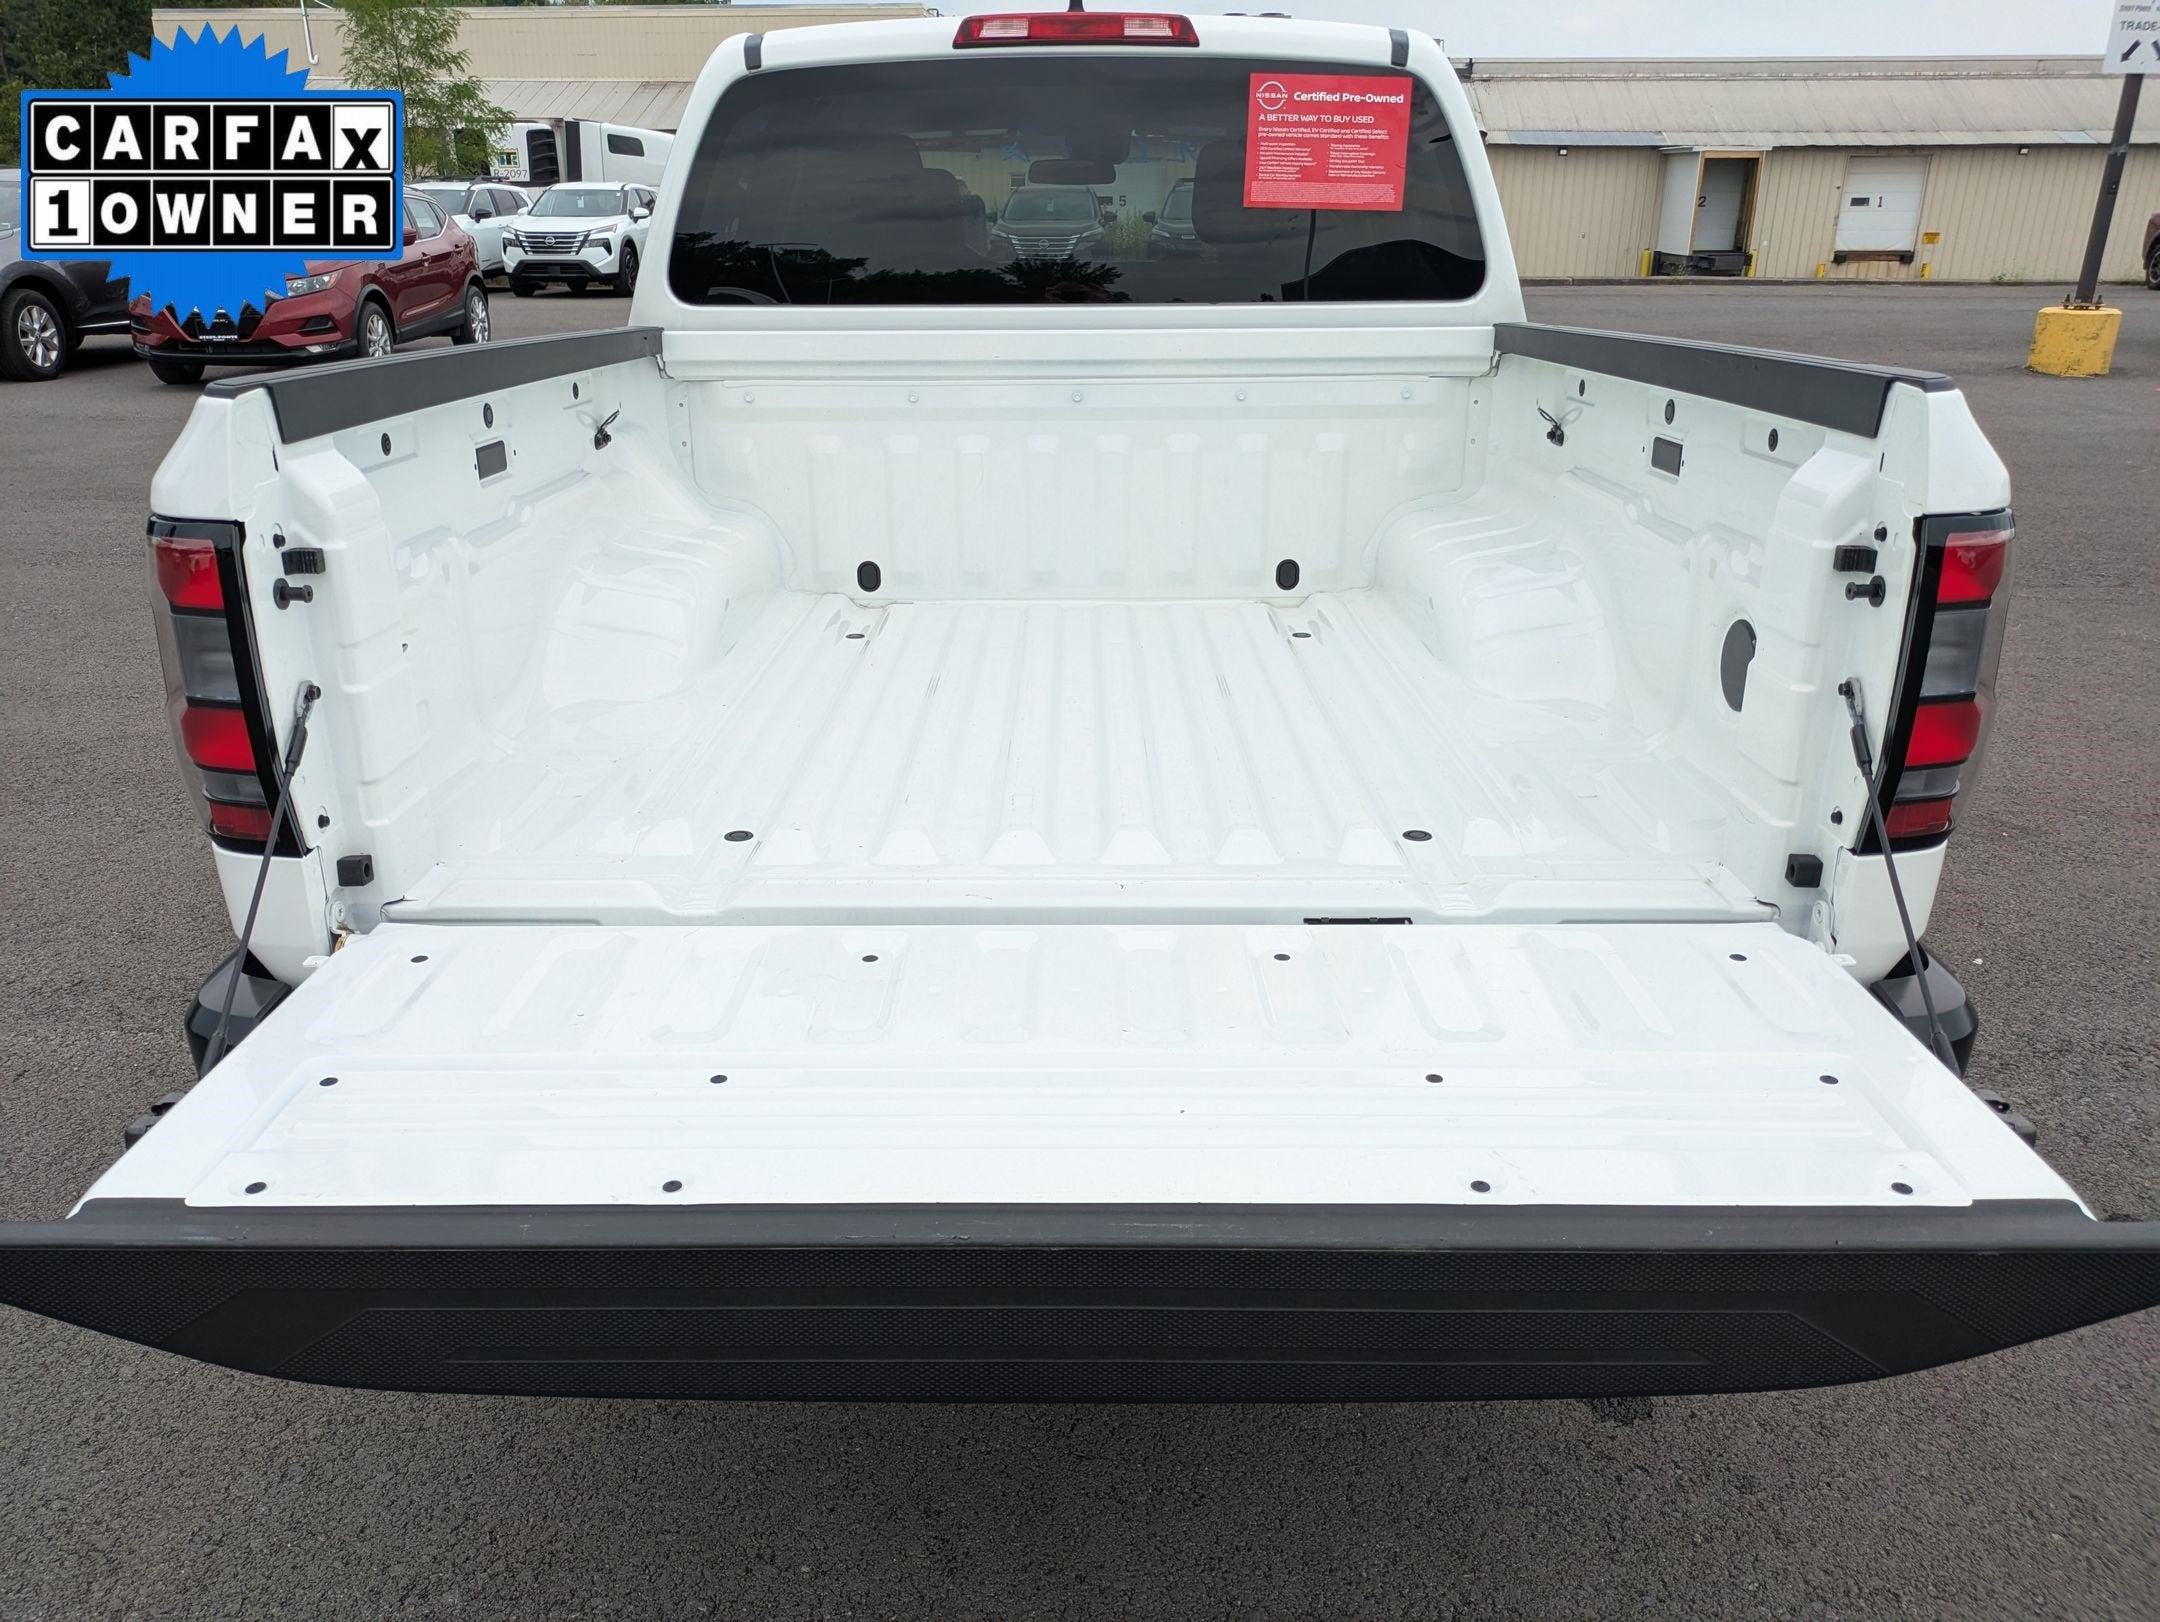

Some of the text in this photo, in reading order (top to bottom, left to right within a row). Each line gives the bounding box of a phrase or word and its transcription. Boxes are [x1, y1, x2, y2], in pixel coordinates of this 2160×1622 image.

[1293, 92, 1404, 104] Certified Pre-Owned
[1259, 113, 1266, 121] A
[1267, 113, 1298, 122] BETTER
[1300, 114, 1318, 122] WAY
[1333, 115, 1351, 123] BUY
[1352, 115, 1374, 124] USED
[1119, 195, 1126, 207] 5
[1697, 196, 1707, 208] 2
[1877, 196, 1883, 208] 1
